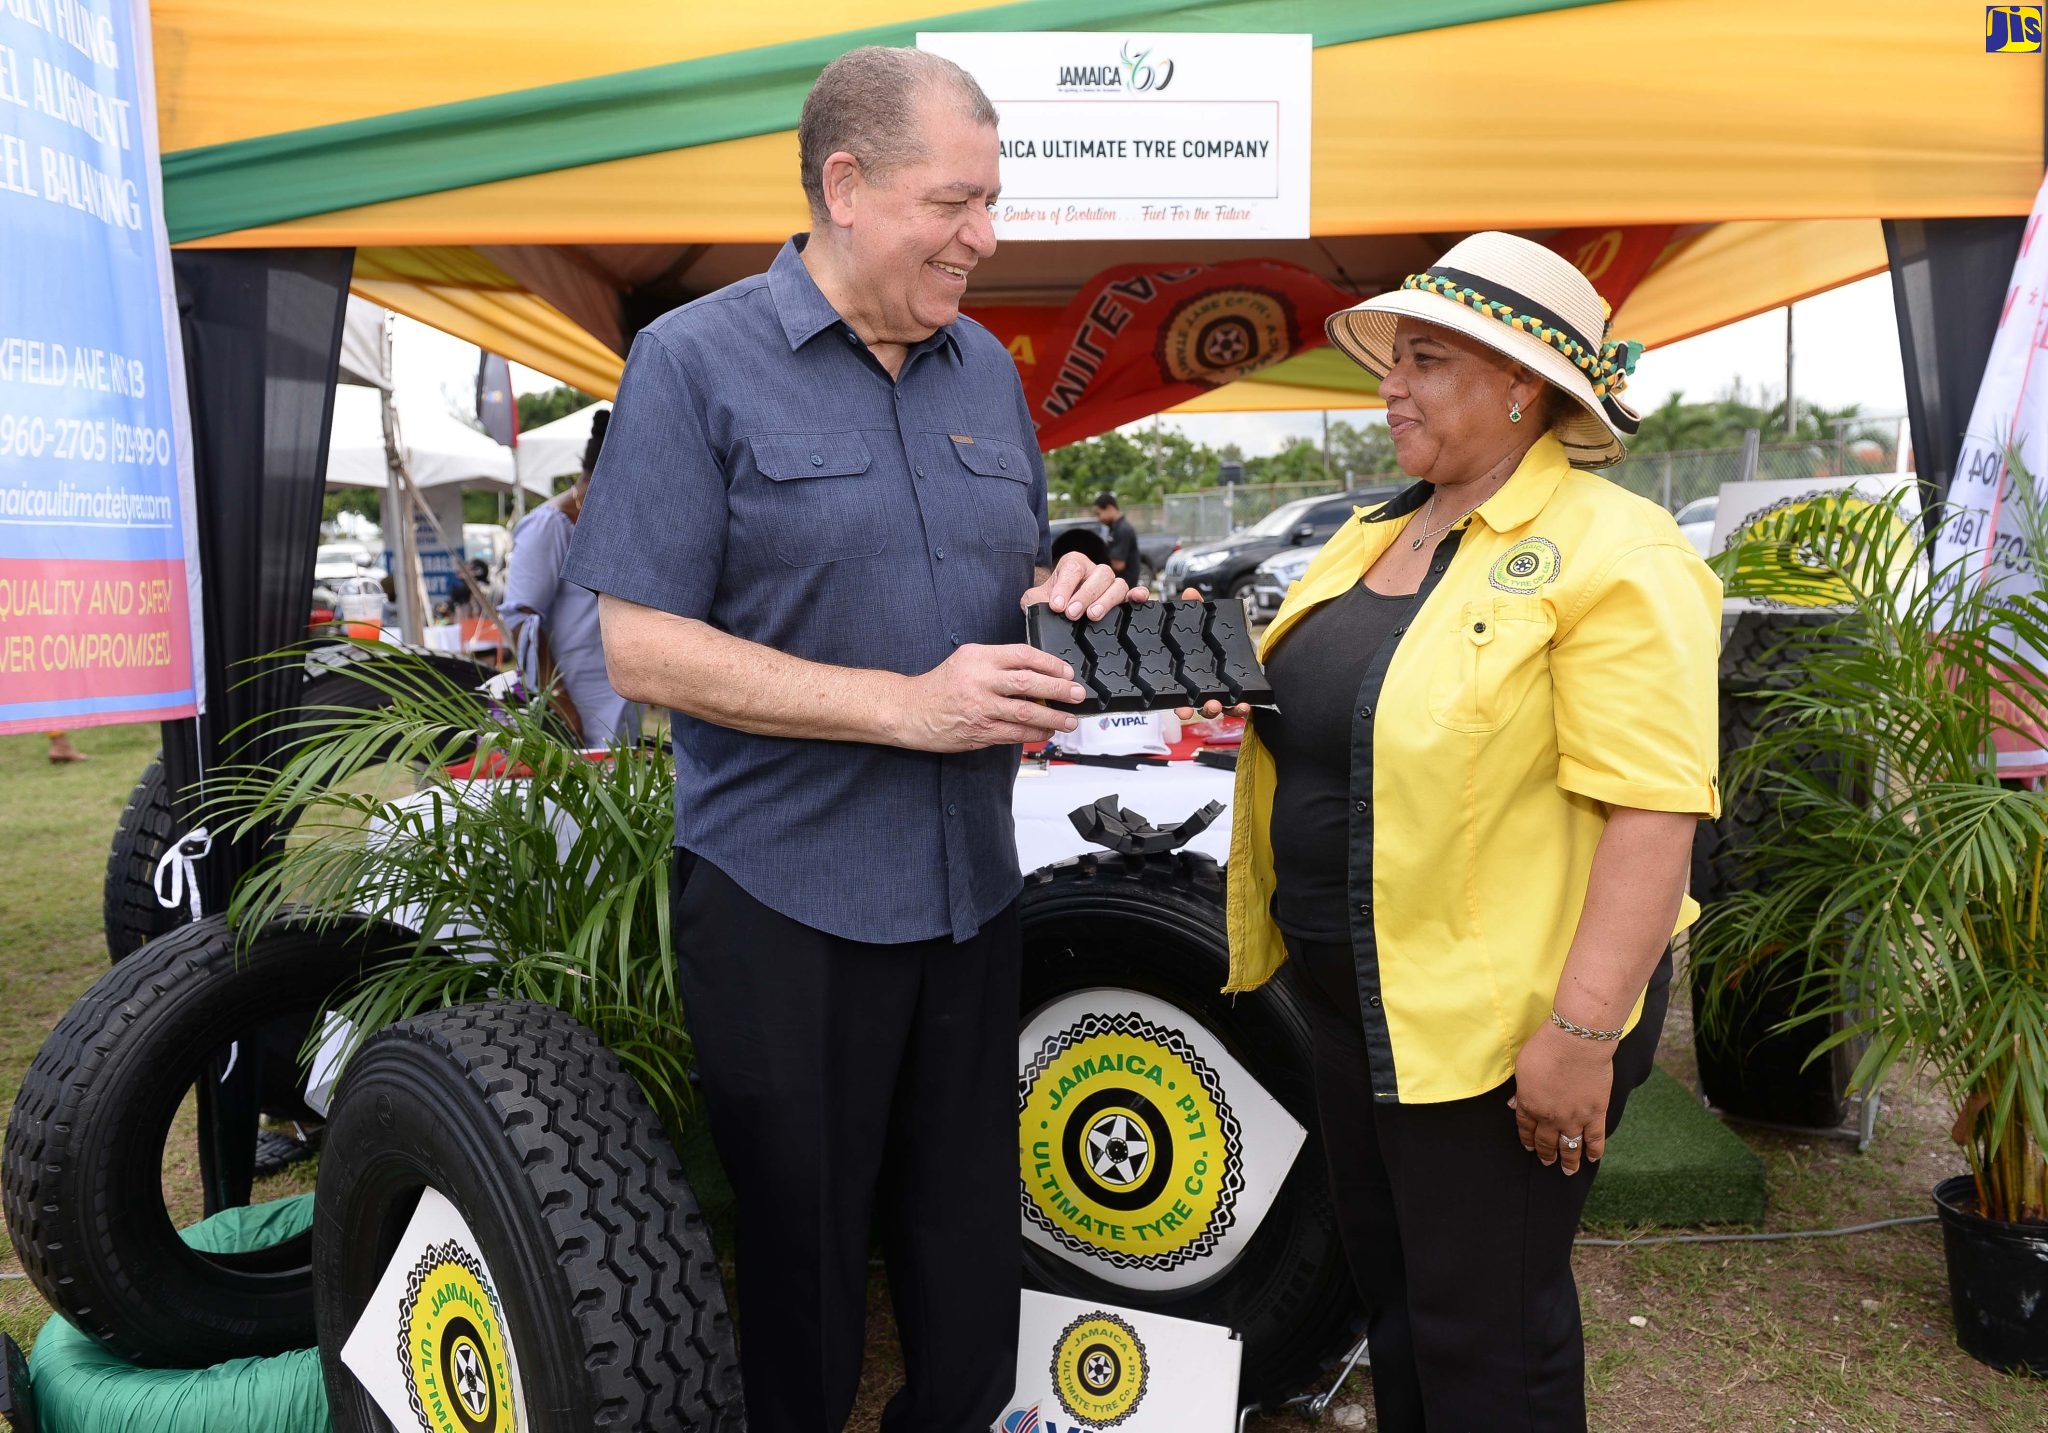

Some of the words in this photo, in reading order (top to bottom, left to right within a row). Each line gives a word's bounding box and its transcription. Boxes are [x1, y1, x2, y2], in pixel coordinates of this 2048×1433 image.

[1057, 66, 1122, 86] JAMAICA
[1000, 140, 1036, 158] AICA
[1042, 140, 1127, 158] ULTIMATE
[1133, 140, 1176, 158] TYRE
[1183, 140, 1269, 158] COMPANY
[1004, 205, 1046, 222] Embers
[1051, 207, 1061, 225] of
[1065, 205, 1117, 222] Evolution
[1141, 205, 1166, 221] Fuel
[1169, 205, 1190, 221] For
[1194, 207, 1210, 220] the
[1215, 205, 1251, 221] Future
[0, 579, 85, 622] QUALITY
[88, 580, 134, 616] AND
[1110, 716, 1149, 728] VIPAL
[1048, 1053, 1164, 1111] JAMAICA
[1176, 1094, 1207, 1141] Ltd
[1032, 1141, 1127, 1241] ULTIMATE
[1132, 1199, 1193, 1241] TYRE
[1184, 1151, 1208, 1196] Co.
[431, 1282, 491, 1341] JAMAICA
[1074, 1328, 1129, 1353] JAMAICA
[421, 1338, 457, 1433] ULTIMA
[1063, 1360, 1090, 1411] ULTIMATE
[1092, 1401, 1119, 1413] TYRE
[1128, 1364, 1136, 1384] Ltd
